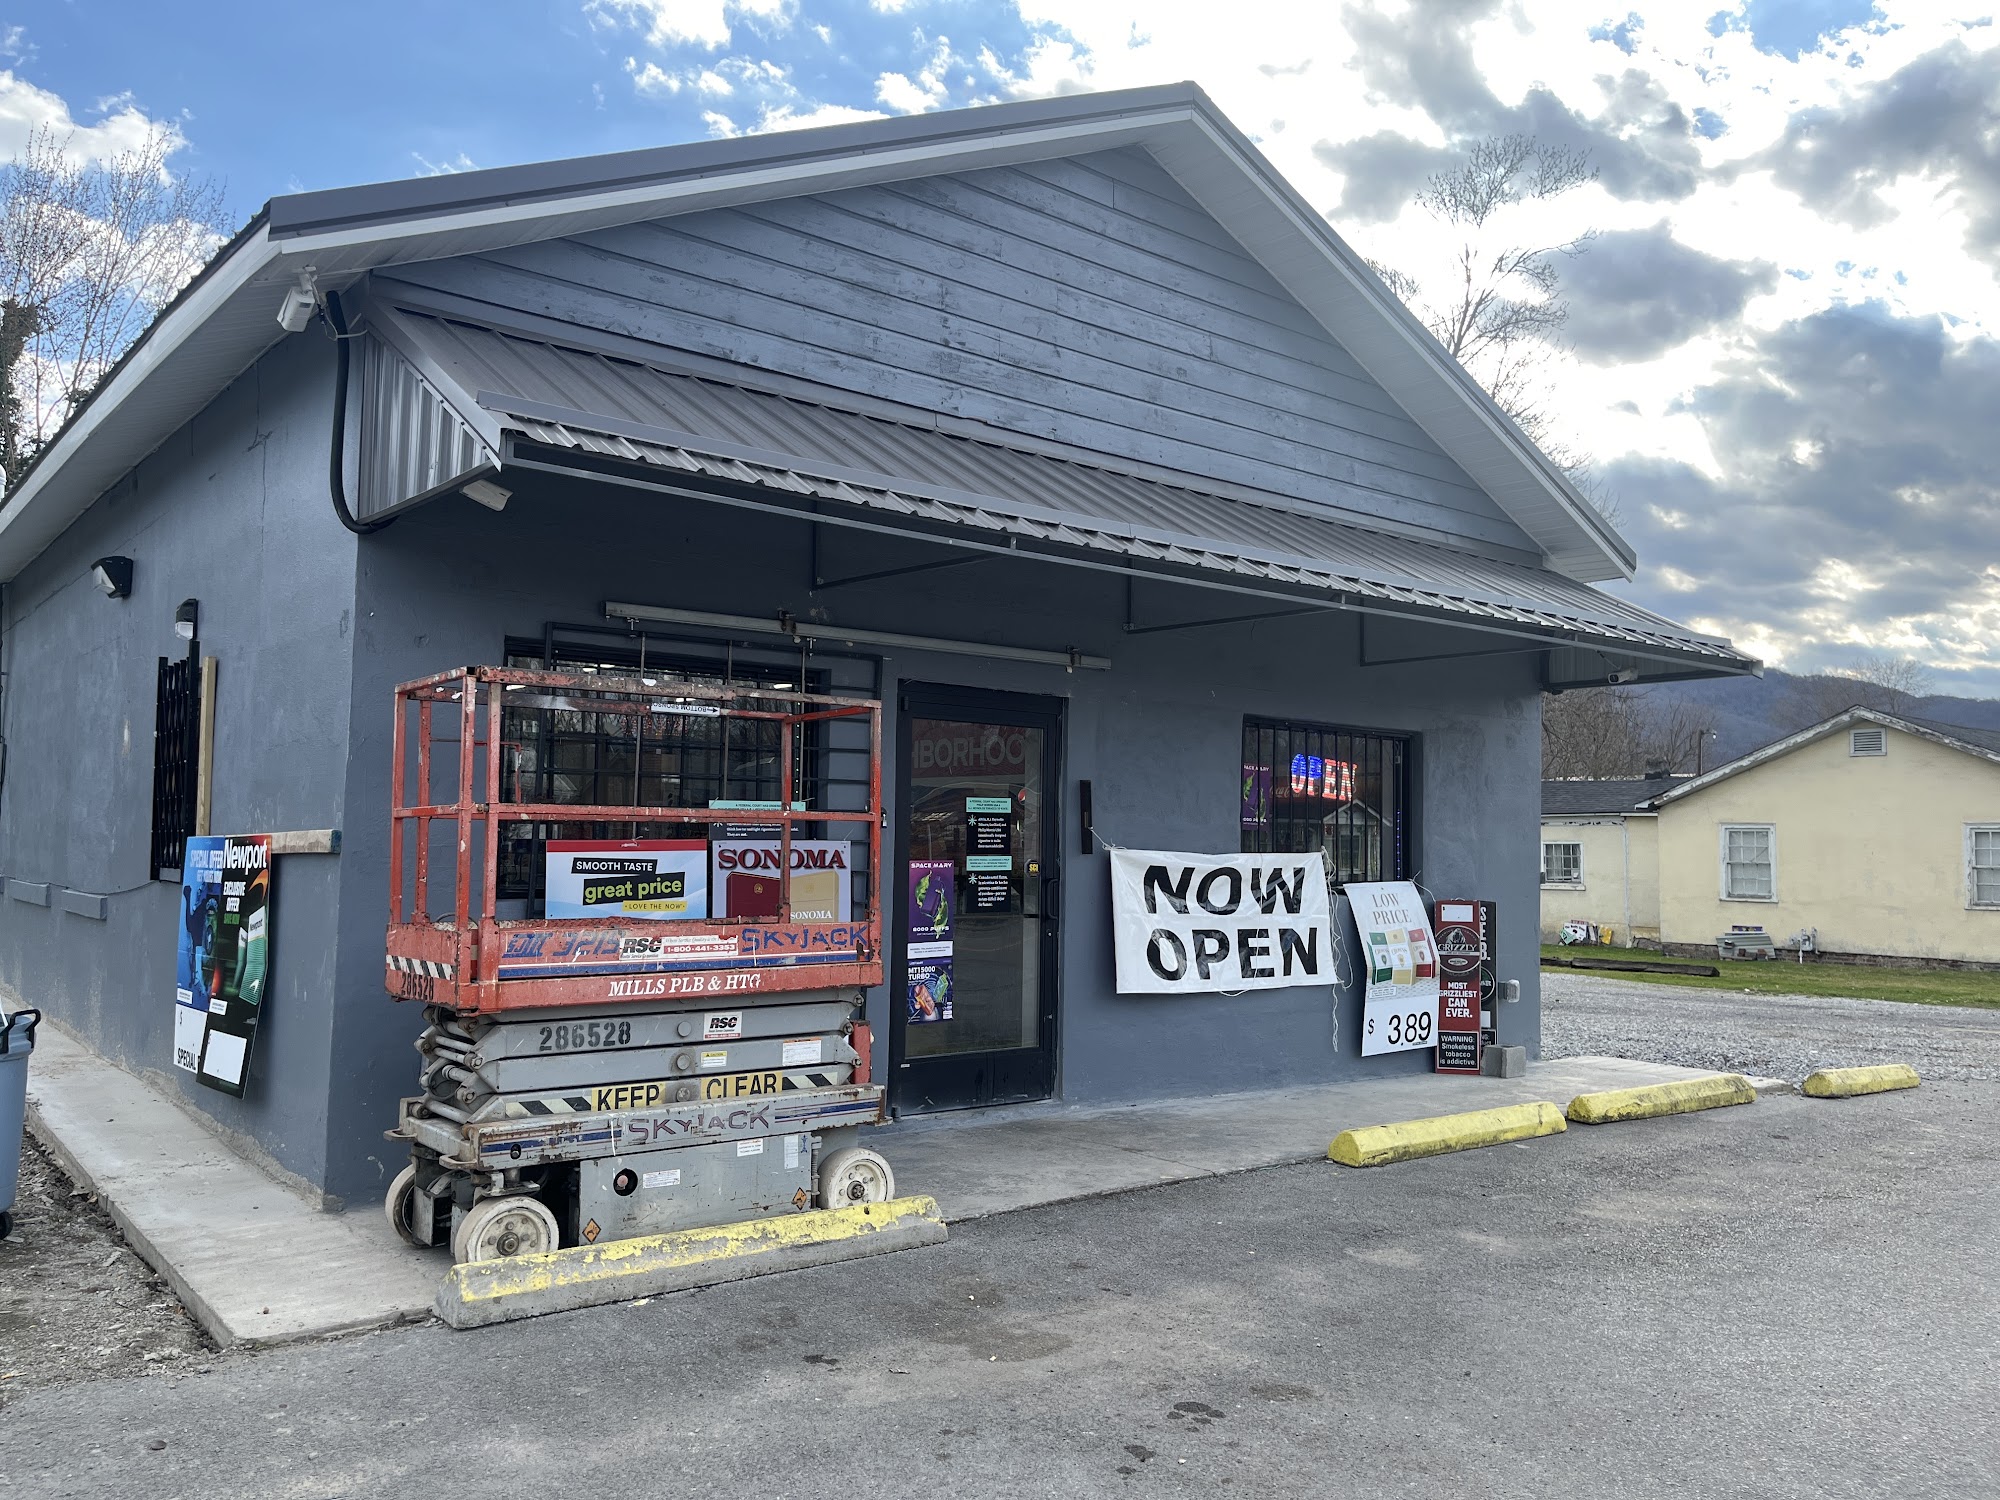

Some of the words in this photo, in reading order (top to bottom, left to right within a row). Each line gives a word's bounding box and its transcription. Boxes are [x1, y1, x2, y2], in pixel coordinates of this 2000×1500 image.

[1291, 753, 1357, 801] OPEN
[223, 838, 267, 876] Newport
[718, 849, 846, 869] SONOMA
[576, 861, 620, 871] SMOOTH
[623, 862, 654, 872] TASTE
[585, 881, 633, 904] great
[637, 877, 682, 900] price
[1143, 865, 1306, 916] NOW
[1372, 893, 1400, 908] LOW
[790, 910, 833, 920] SONOMA
[1373, 909, 1412, 925] PRICE
[622, 938, 662, 953] RSC
[742, 926, 867, 952] SKYJACK
[1438, 943, 1477, 951] GRIZZLY
[1147, 927, 1318, 981] OPEN
[608, 978, 667, 997] MILLS
[669, 976, 704, 993] PLB
[707, 975, 721, 991] &
[1439, 989, 1477, 998] GRIZZLIEST
[1447, 998, 1468, 1007] CAN
[1445, 1007, 1473, 1018] EVER.
[710, 1016, 738, 1029] RSC
[1368, 1018, 1375, 1035] $
[539, 1021, 631, 1052] 286528
[1441, 1042, 1475, 1050] Smokeless
[177, 1047, 197, 1071] SPECIAL
[706, 1073, 776, 1100] CLEAR
[598, 1084, 660, 1111] KEEP
